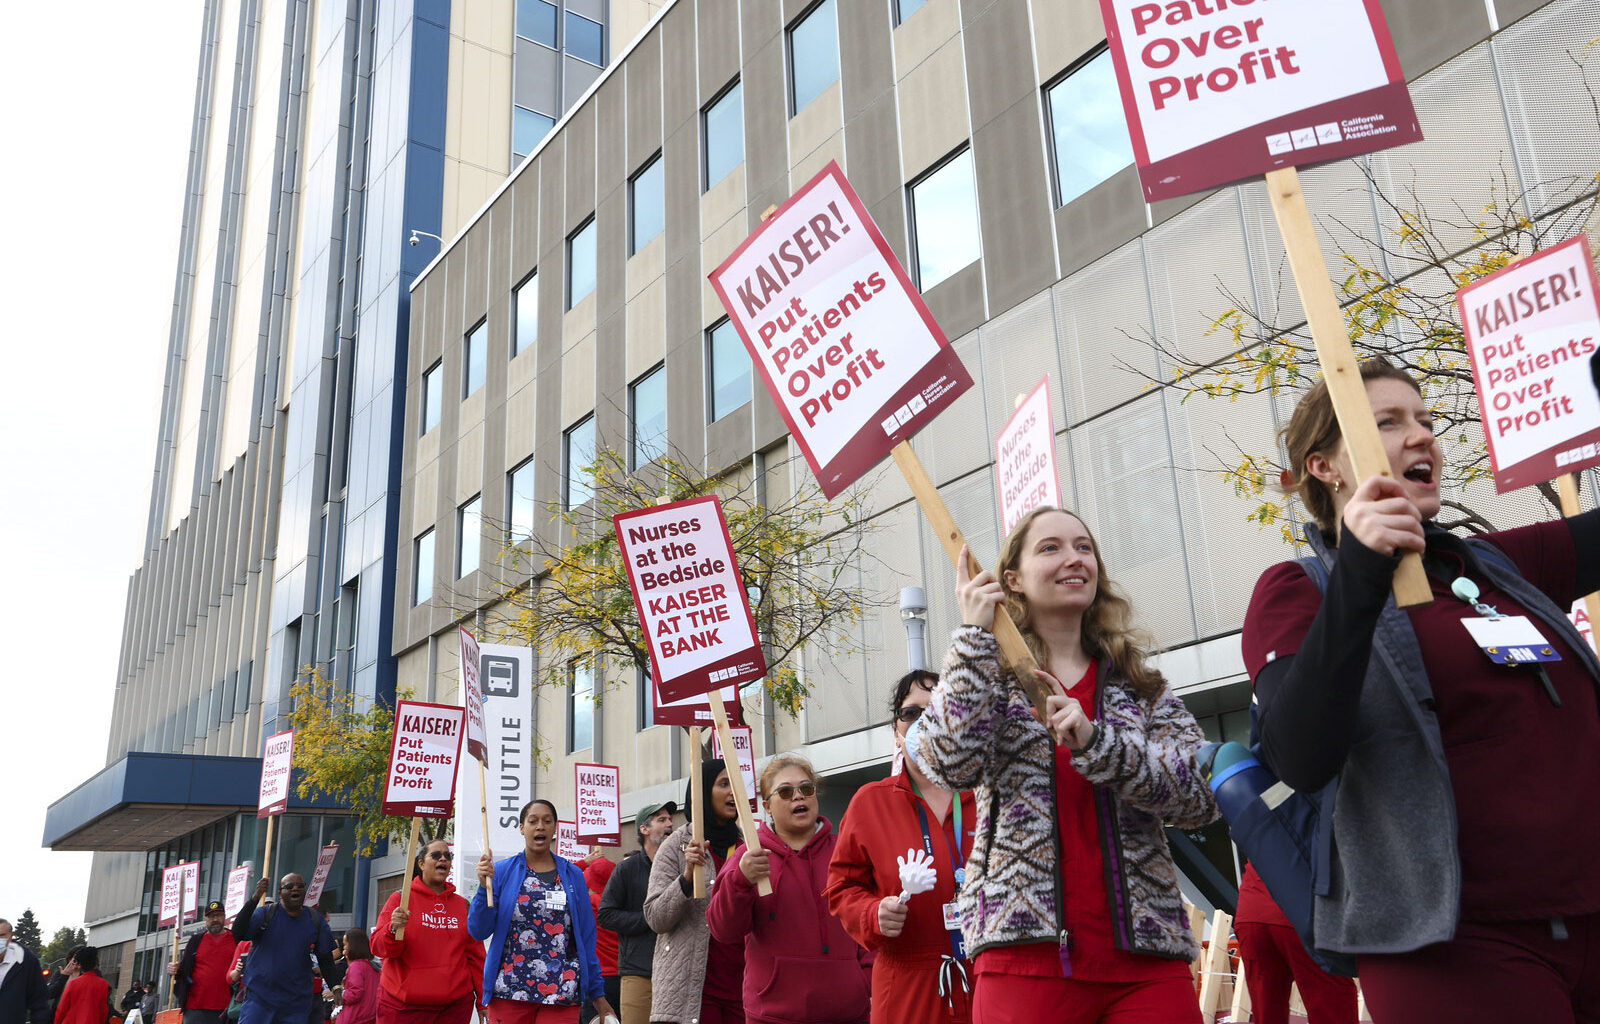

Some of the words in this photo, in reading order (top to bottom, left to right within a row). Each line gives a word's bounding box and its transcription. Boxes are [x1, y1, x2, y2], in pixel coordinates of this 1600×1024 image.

[1141, 17, 1264, 69] Over
[1148, 46, 1300, 111] Profit
[1341, 113, 1384, 127] California
[1343, 122, 1374, 134] Nurses
[1345, 125, 1397, 140] Association
[736, 200, 851, 319] KAISER!
[1474, 265, 1583, 338] KAISER!
[757, 295, 808, 349] Put
[772, 270, 886, 375] Patients
[1482, 333, 1525, 366] Put
[788, 332, 853, 398] Over
[1487, 335, 1596, 390] Patients
[799, 347, 885, 428] Profit
[922, 375, 947, 396] California
[928, 380, 957, 404] Association
[1493, 376, 1555, 412] Over
[1497, 395, 1574, 438] Profit
[1002, 411, 1037, 462] Nurses
[1014, 442, 1032, 470] the
[1006, 452, 1048, 509] Bedside
[628, 518, 701, 545] Nurses
[636, 548, 658, 568] at
[661, 542, 697, 562] the
[640, 557, 725, 591] Bedside
[648, 583, 728, 617] KAISER
[657, 616, 681, 638] AT
[686, 604, 731, 629] THE
[660, 627, 724, 659] BANK
[1507, 647, 1538, 661] RN
[401, 714, 458, 737] KAISER!
[267, 740, 290, 758] KAISER!
[399, 736, 423, 749] Put
[265, 761, 275, 769] Put
[397, 749, 453, 765] Patients
[264, 766, 288, 778] Patients
[395, 762, 430, 776] Over
[499, 717, 521, 829] SHUTTLE
[580, 772, 615, 788] KAISER!
[262, 786, 278, 797] Profit
[263, 779, 277, 788] Over
[393, 775, 433, 790] Profit
[580, 788, 596, 797] Put
[580, 797, 616, 808] Patients
[580, 807, 603, 816] Over
[580, 816, 607, 826] Profit
[559, 841, 573, 849] Put
[560, 828, 576, 840] KAIS
[165, 883, 177, 891] Put
[164, 897, 178, 905] Ove
